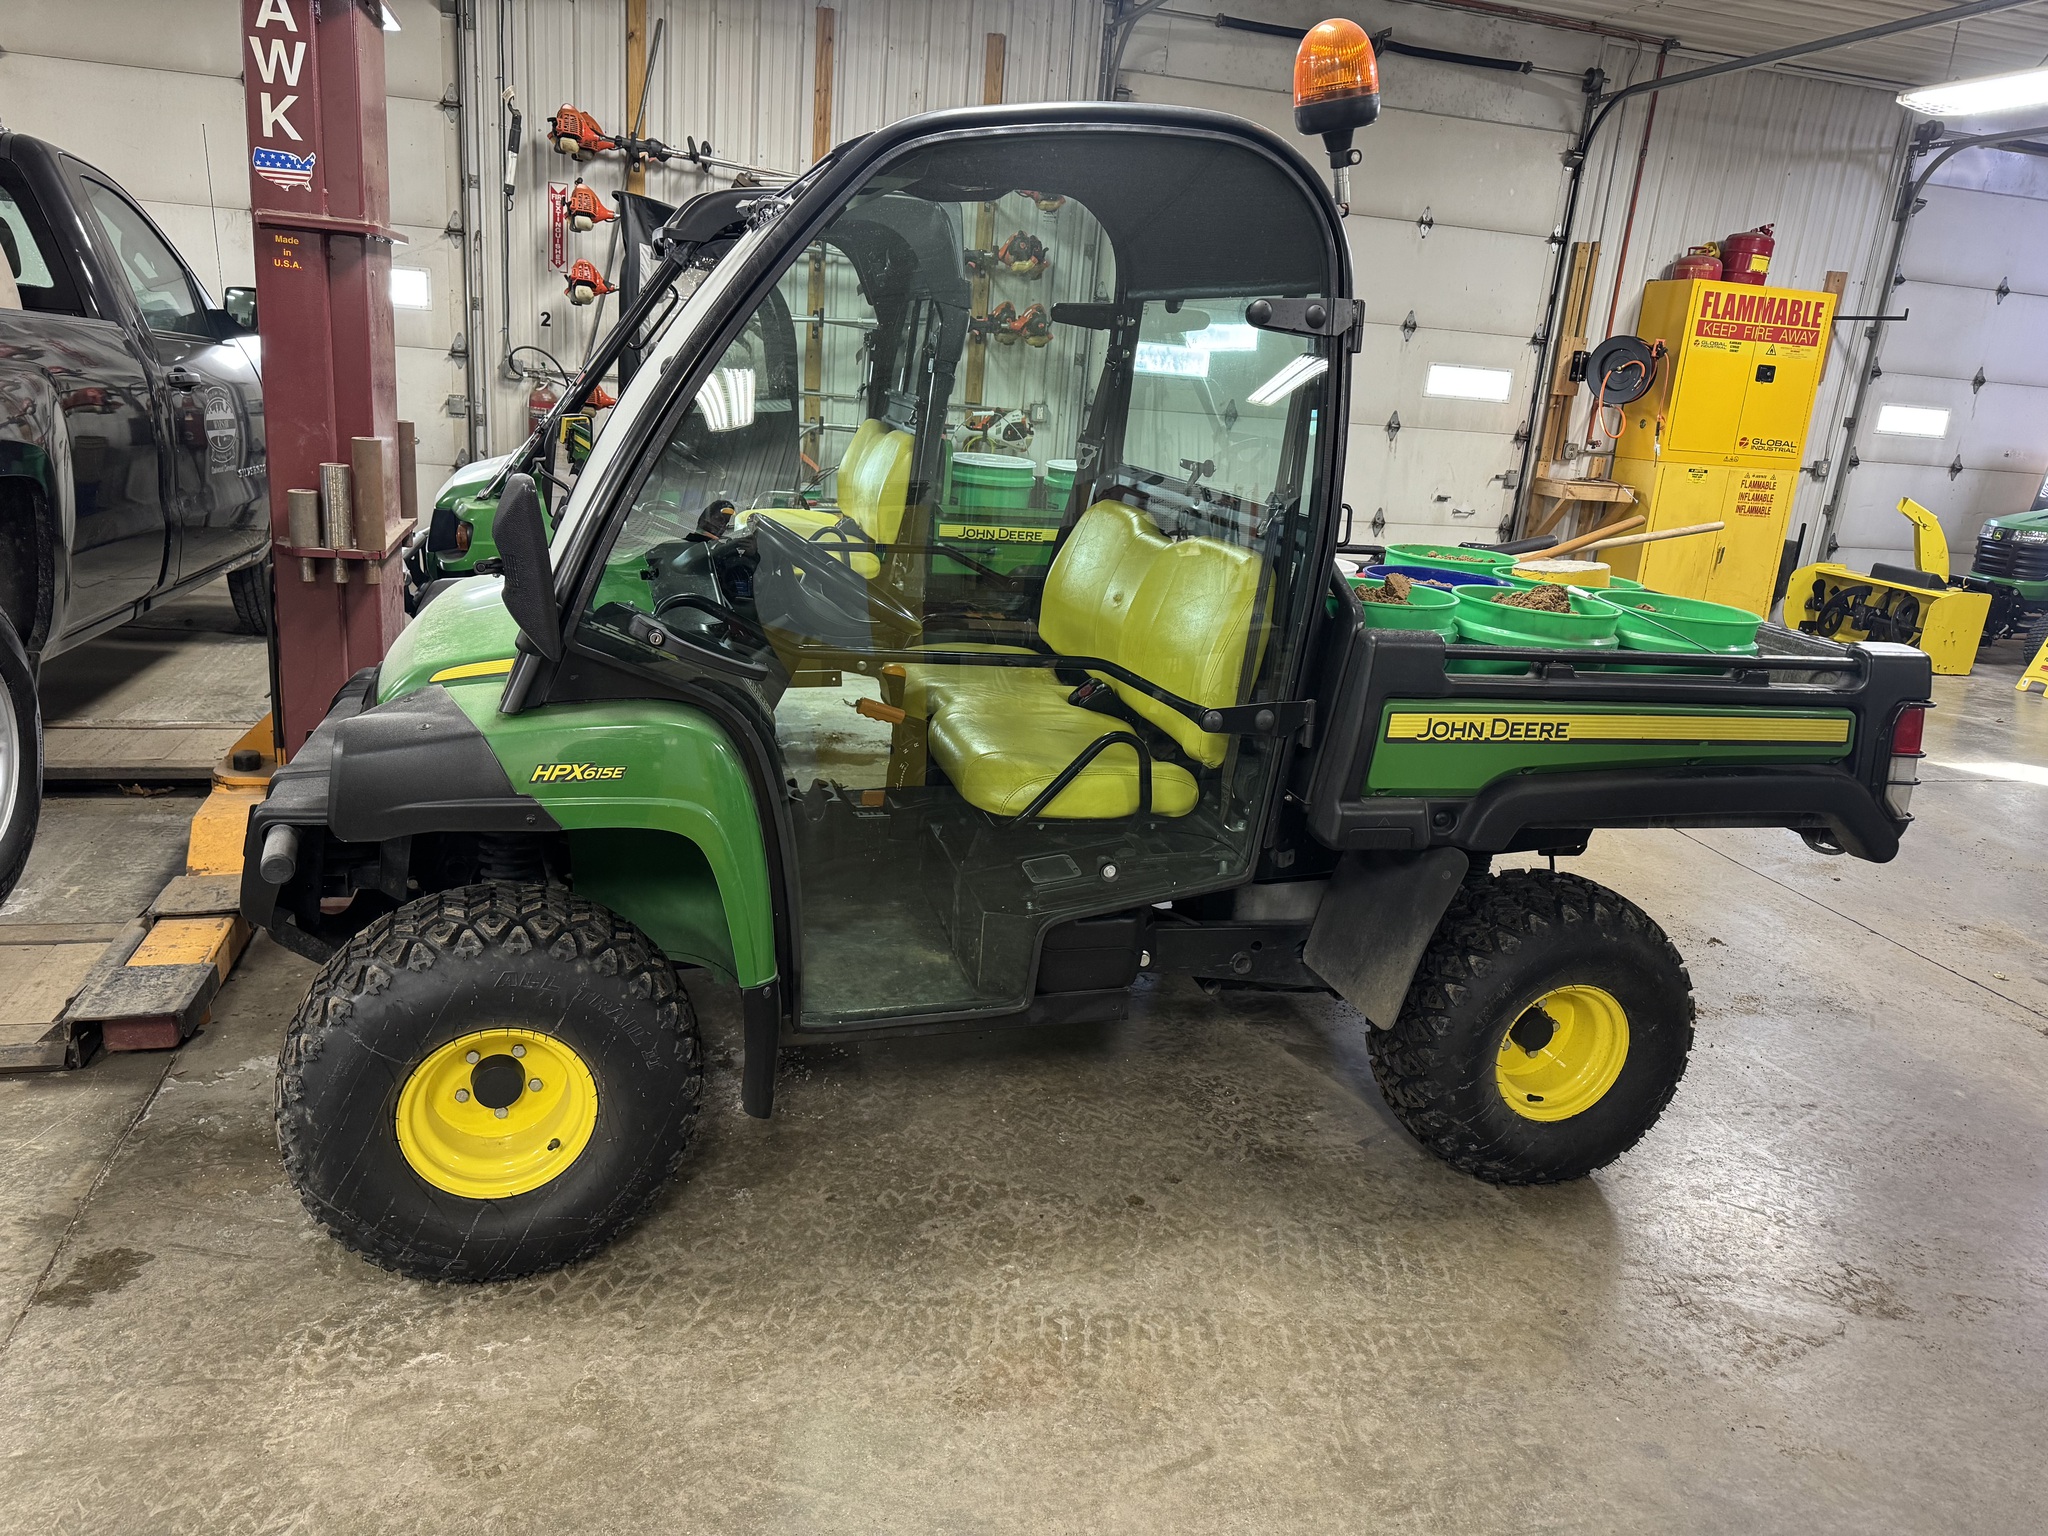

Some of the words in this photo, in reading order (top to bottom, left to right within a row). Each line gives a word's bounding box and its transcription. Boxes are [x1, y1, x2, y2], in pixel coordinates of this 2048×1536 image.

[275, 234, 299, 245] Made
[283, 248, 292, 256] in
[274, 258, 302, 269] U.S.A.
[1700, 290, 1825, 328] FLAMMABLE
[540, 311, 551, 327] 2
[1702, 321, 1737, 337] KEEP
[1744, 325, 1773, 341] FIRE
[1779, 328, 1817, 344] AWAY
[1751, 437, 1797, 448] GLOBAL
[1750, 445, 1796, 454] INDUSTRIAL
[1740, 479, 1777, 491] FLAMMABLE
[1737, 491, 1775, 503] INFLAMABLE
[1735, 504, 1772, 515] INFLAMMABLE
[958, 526, 995, 539] JOHN
[998, 528, 1043, 541] DEERE
[1417, 717, 1485, 739] JOHN
[1490, 718, 1570, 739] DEERE
[494, 970, 560, 993] ALL
[573, 985, 643, 1047] TRAIL
